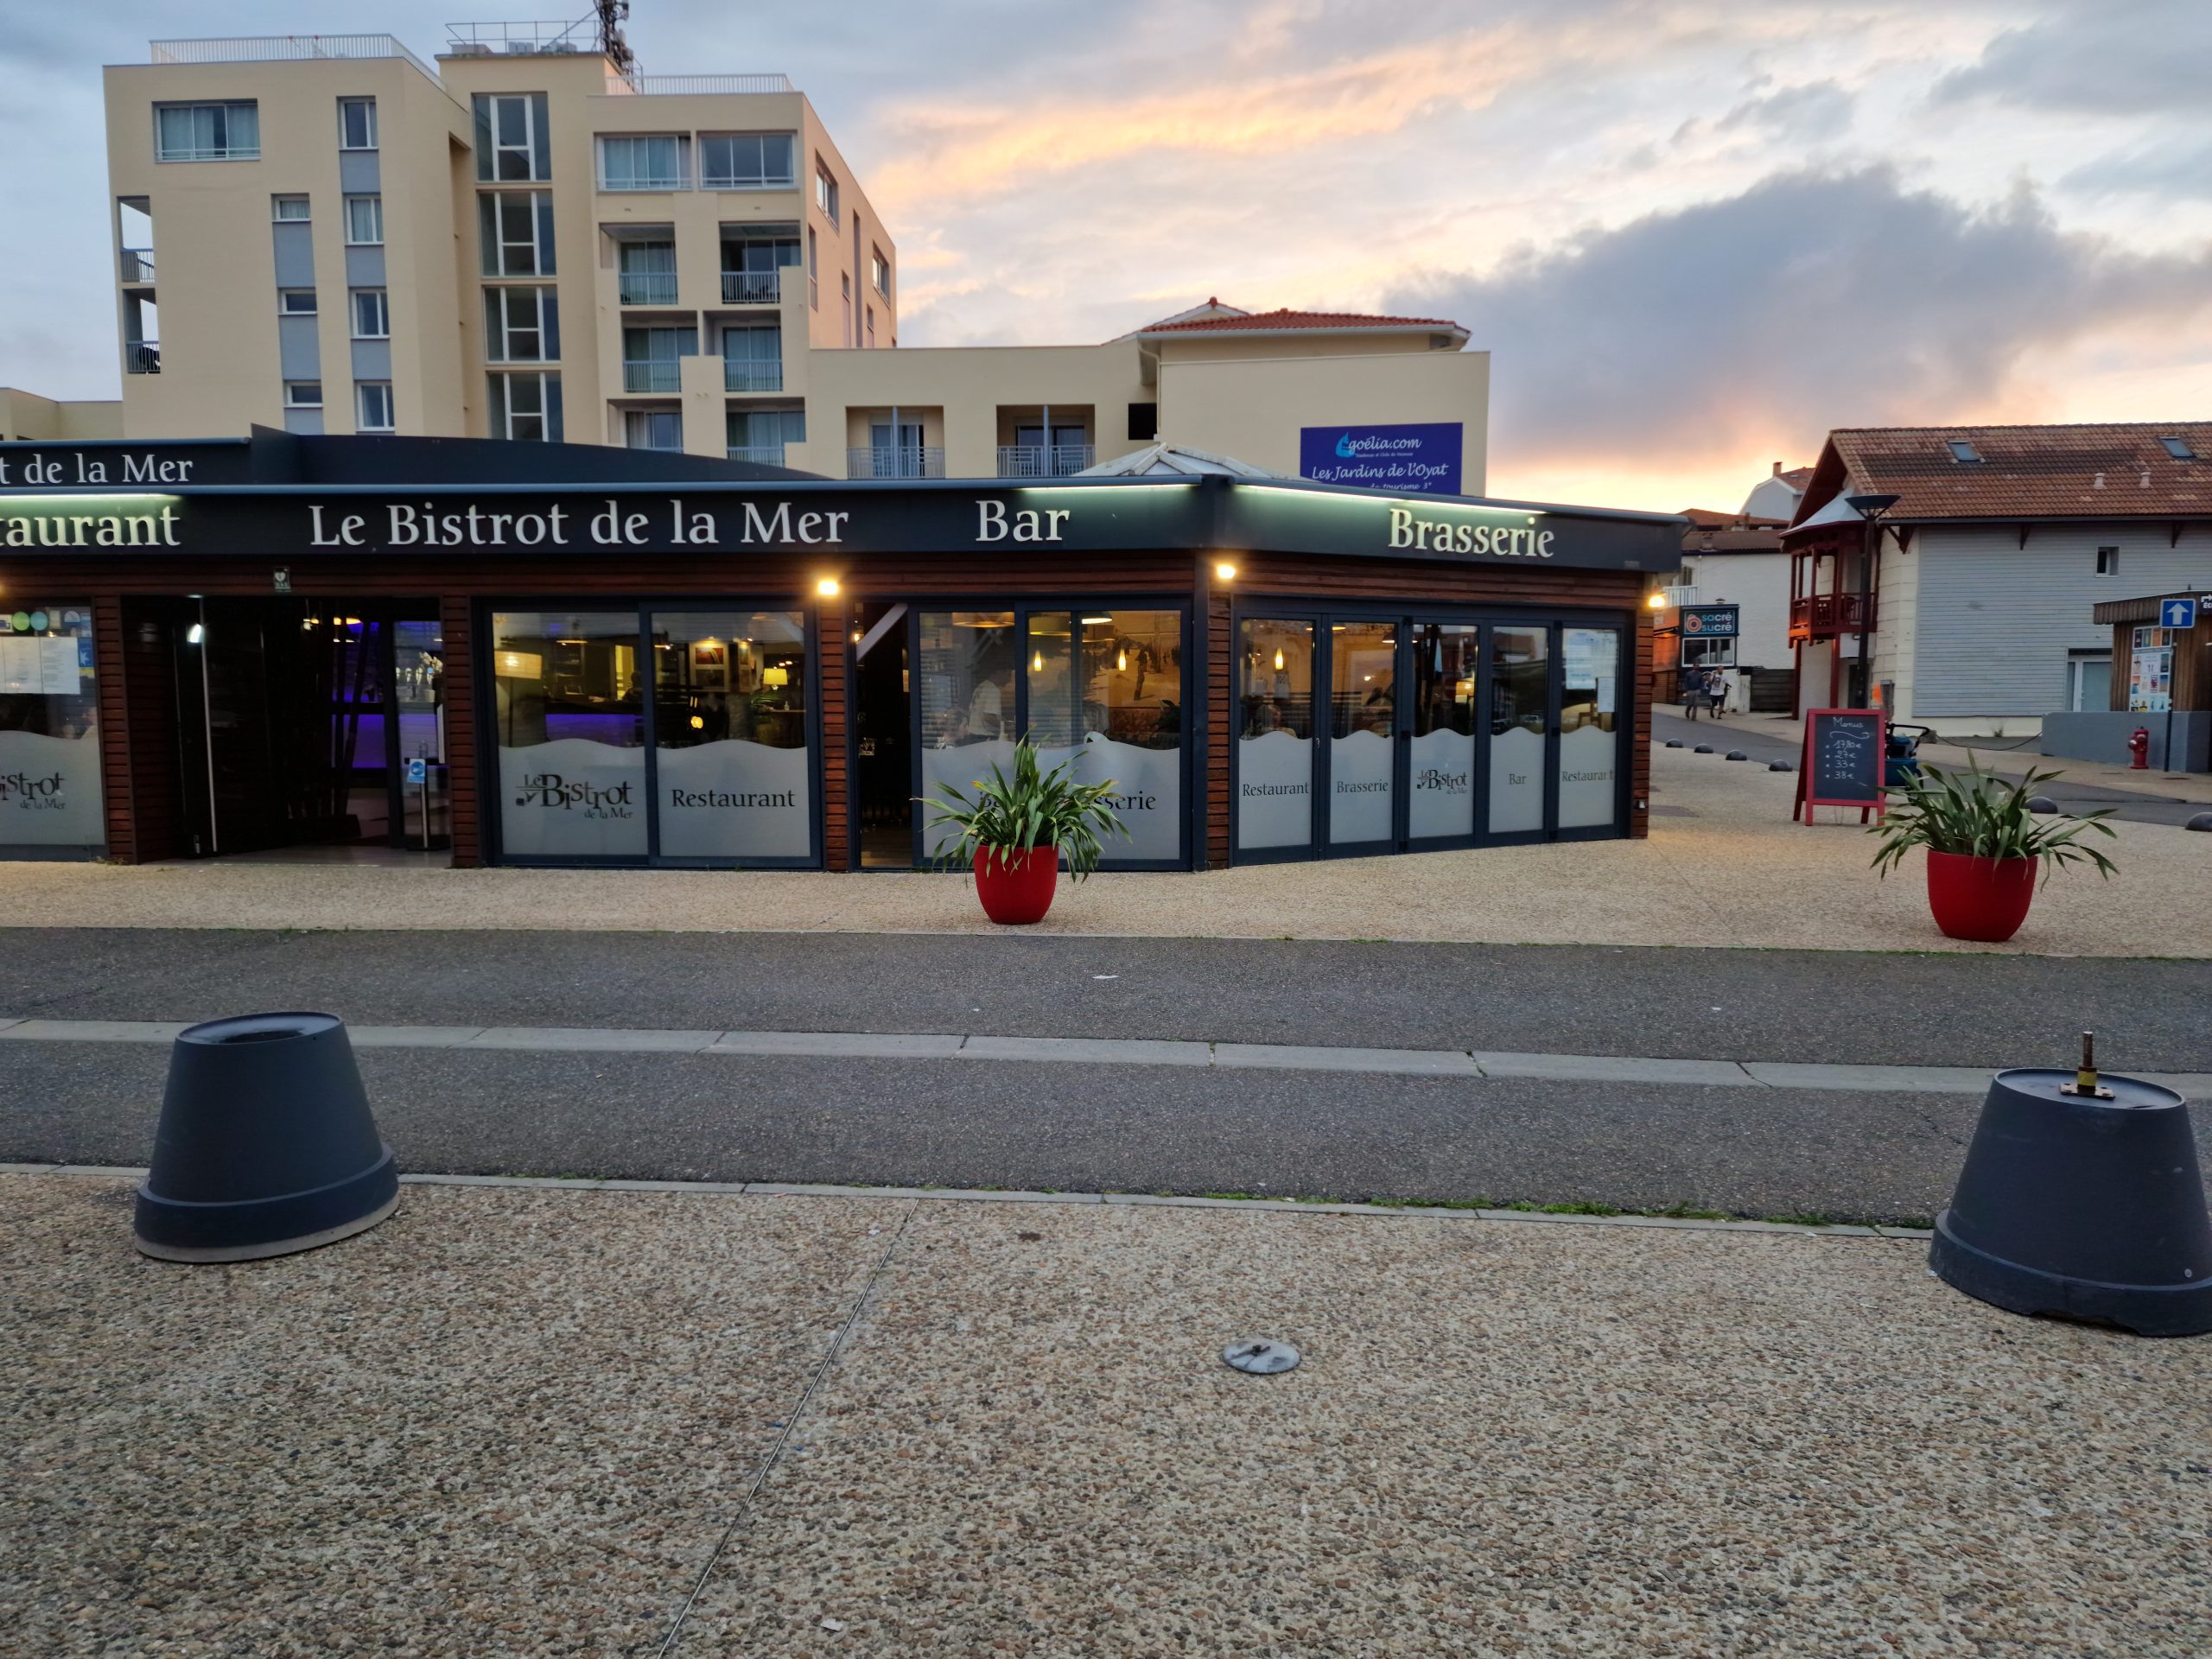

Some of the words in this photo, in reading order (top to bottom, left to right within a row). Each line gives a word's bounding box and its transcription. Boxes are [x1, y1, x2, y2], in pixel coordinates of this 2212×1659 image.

[1348, 435, 1421, 454] goélia.com
[24, 454, 62, 484] de
[75, 453, 108, 483] la
[122, 454, 194, 482] Mer
[1313, 466, 1333, 480] Les
[1332, 464, 1386, 481] Jardins
[1388, 462, 1407, 477] de
[1408, 461, 1449, 480] l'Oyat
[0, 505, 181, 546] aurant
[308, 505, 366, 545] Le
[386, 501, 569, 545] Bistrot
[590, 499, 649, 544] de
[670, 499, 719, 543] la
[741, 501, 849, 543] Mer
[976, 499, 1070, 542] Bar
[1388, 508, 1555, 558] Brasserie
[1701, 612, 1732, 621] sacré
[1701, 622, 1732, 632] sucré
[1337, 779, 1389, 793] Brasserie
[1427, 769, 1467, 791] Bistrot
[1509, 773, 1527, 785] Bar
[524, 774, 542, 787] Le
[538, 773, 633, 810] Bistrot
[671, 789, 795, 807] Restaurant
[1243, 782, 1310, 797] Restaurant
[45, 798, 66, 810] Mer
[583, 808, 596, 818] de
[599, 807, 608, 819] la
[610, 807, 633, 818] Mer
